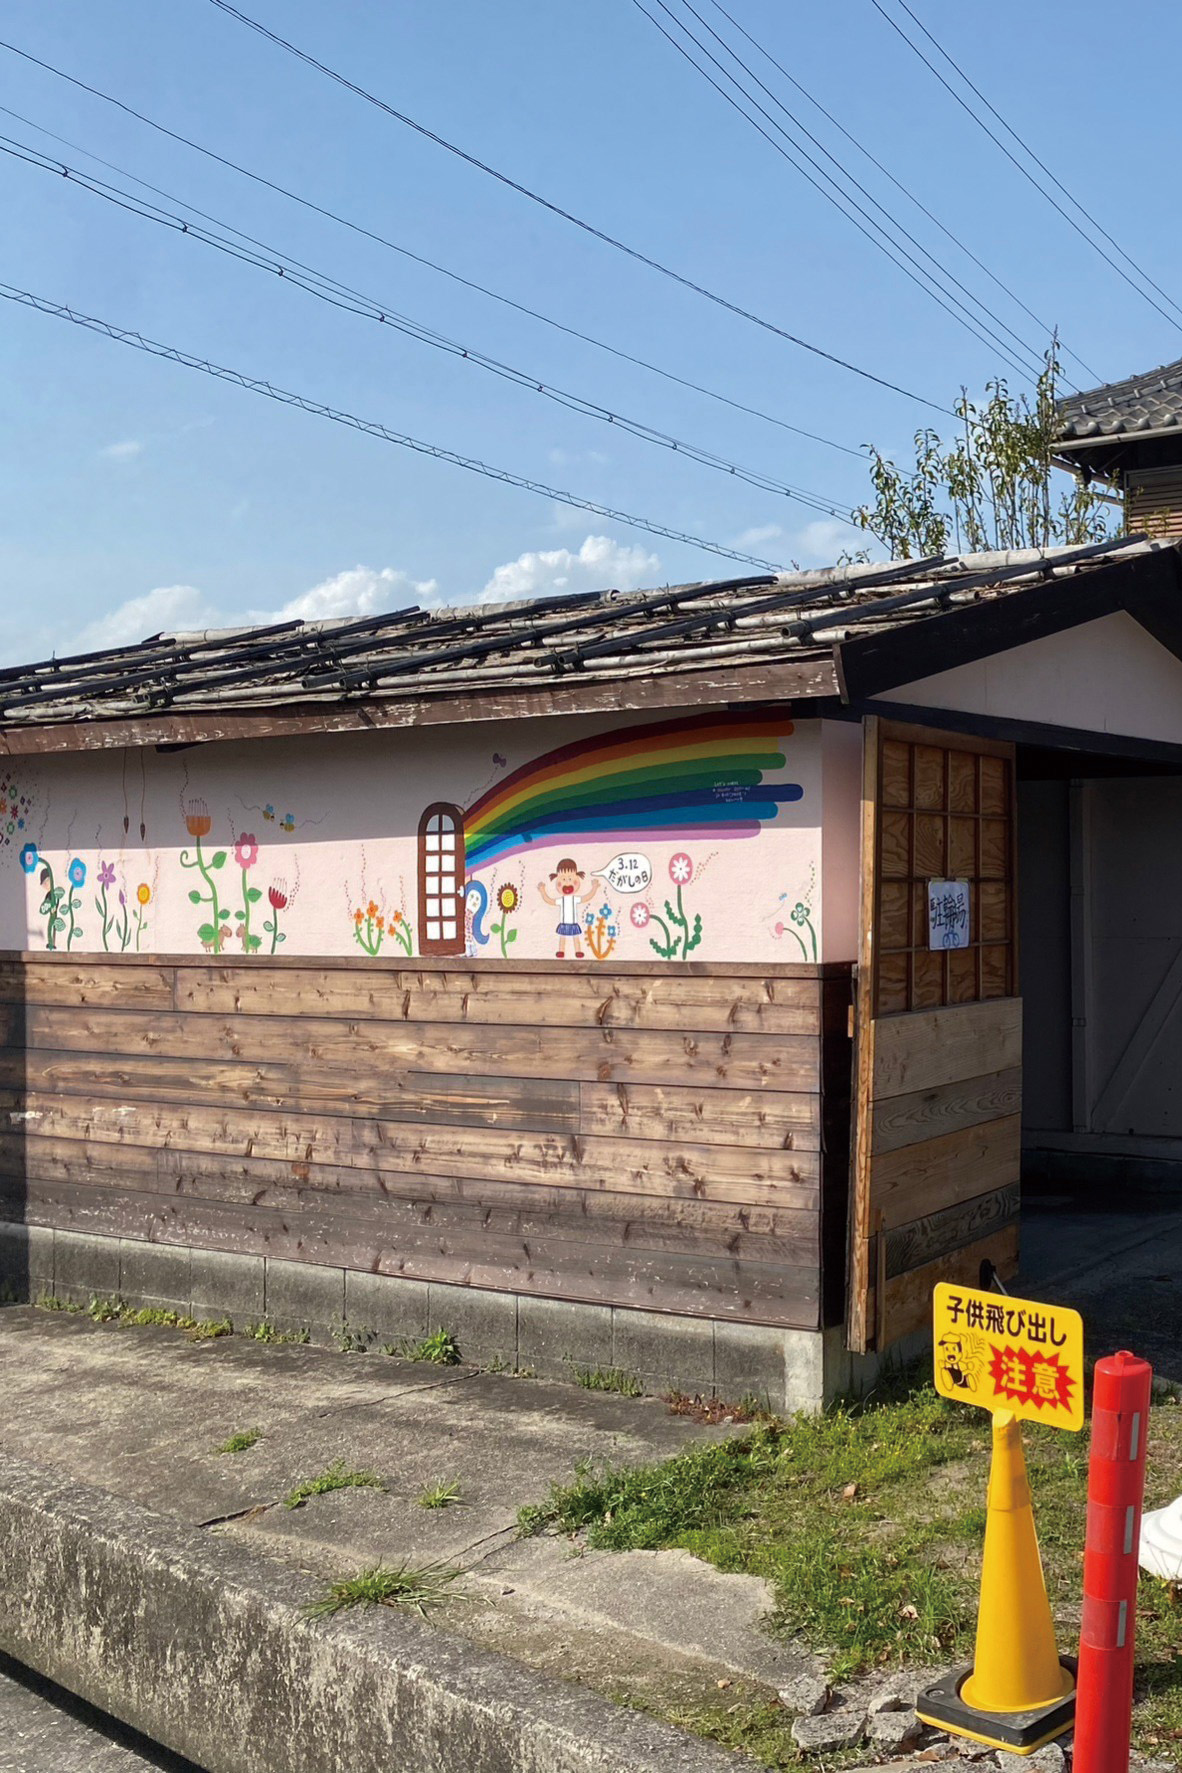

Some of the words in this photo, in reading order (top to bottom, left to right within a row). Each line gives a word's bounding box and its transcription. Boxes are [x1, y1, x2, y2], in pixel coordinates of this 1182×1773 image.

[608, 868, 649, 888] だがしの日
[617, 857, 639, 870] 3.12
[946, 1295, 1067, 1347] 子供飛び出し
[1000, 1355, 1060, 1401] 注意
